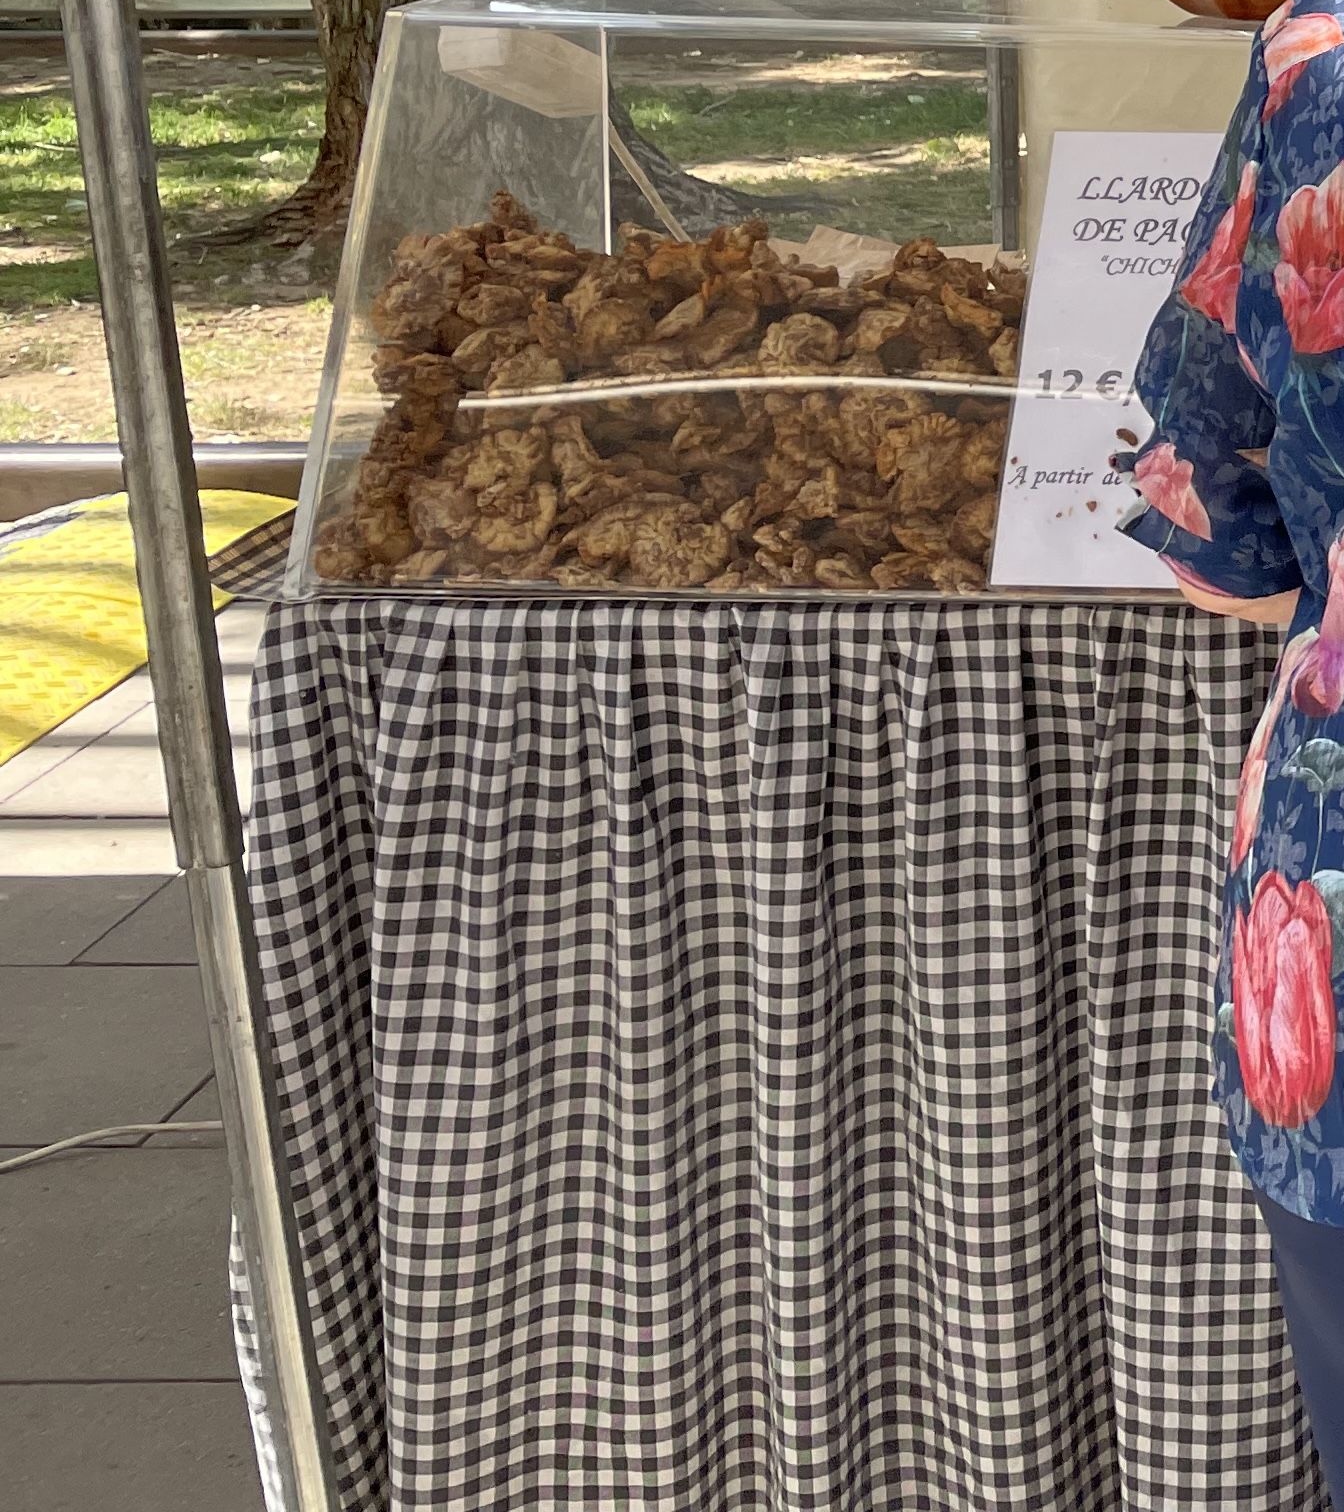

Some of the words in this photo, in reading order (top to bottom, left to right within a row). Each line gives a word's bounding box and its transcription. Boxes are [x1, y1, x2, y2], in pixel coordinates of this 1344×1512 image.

[1073, 218, 1126, 242] DE
[1035, 369, 1084, 400] 12
[1008, 465, 1029, 485] A
[1030, 467, 1094, 489] partir
